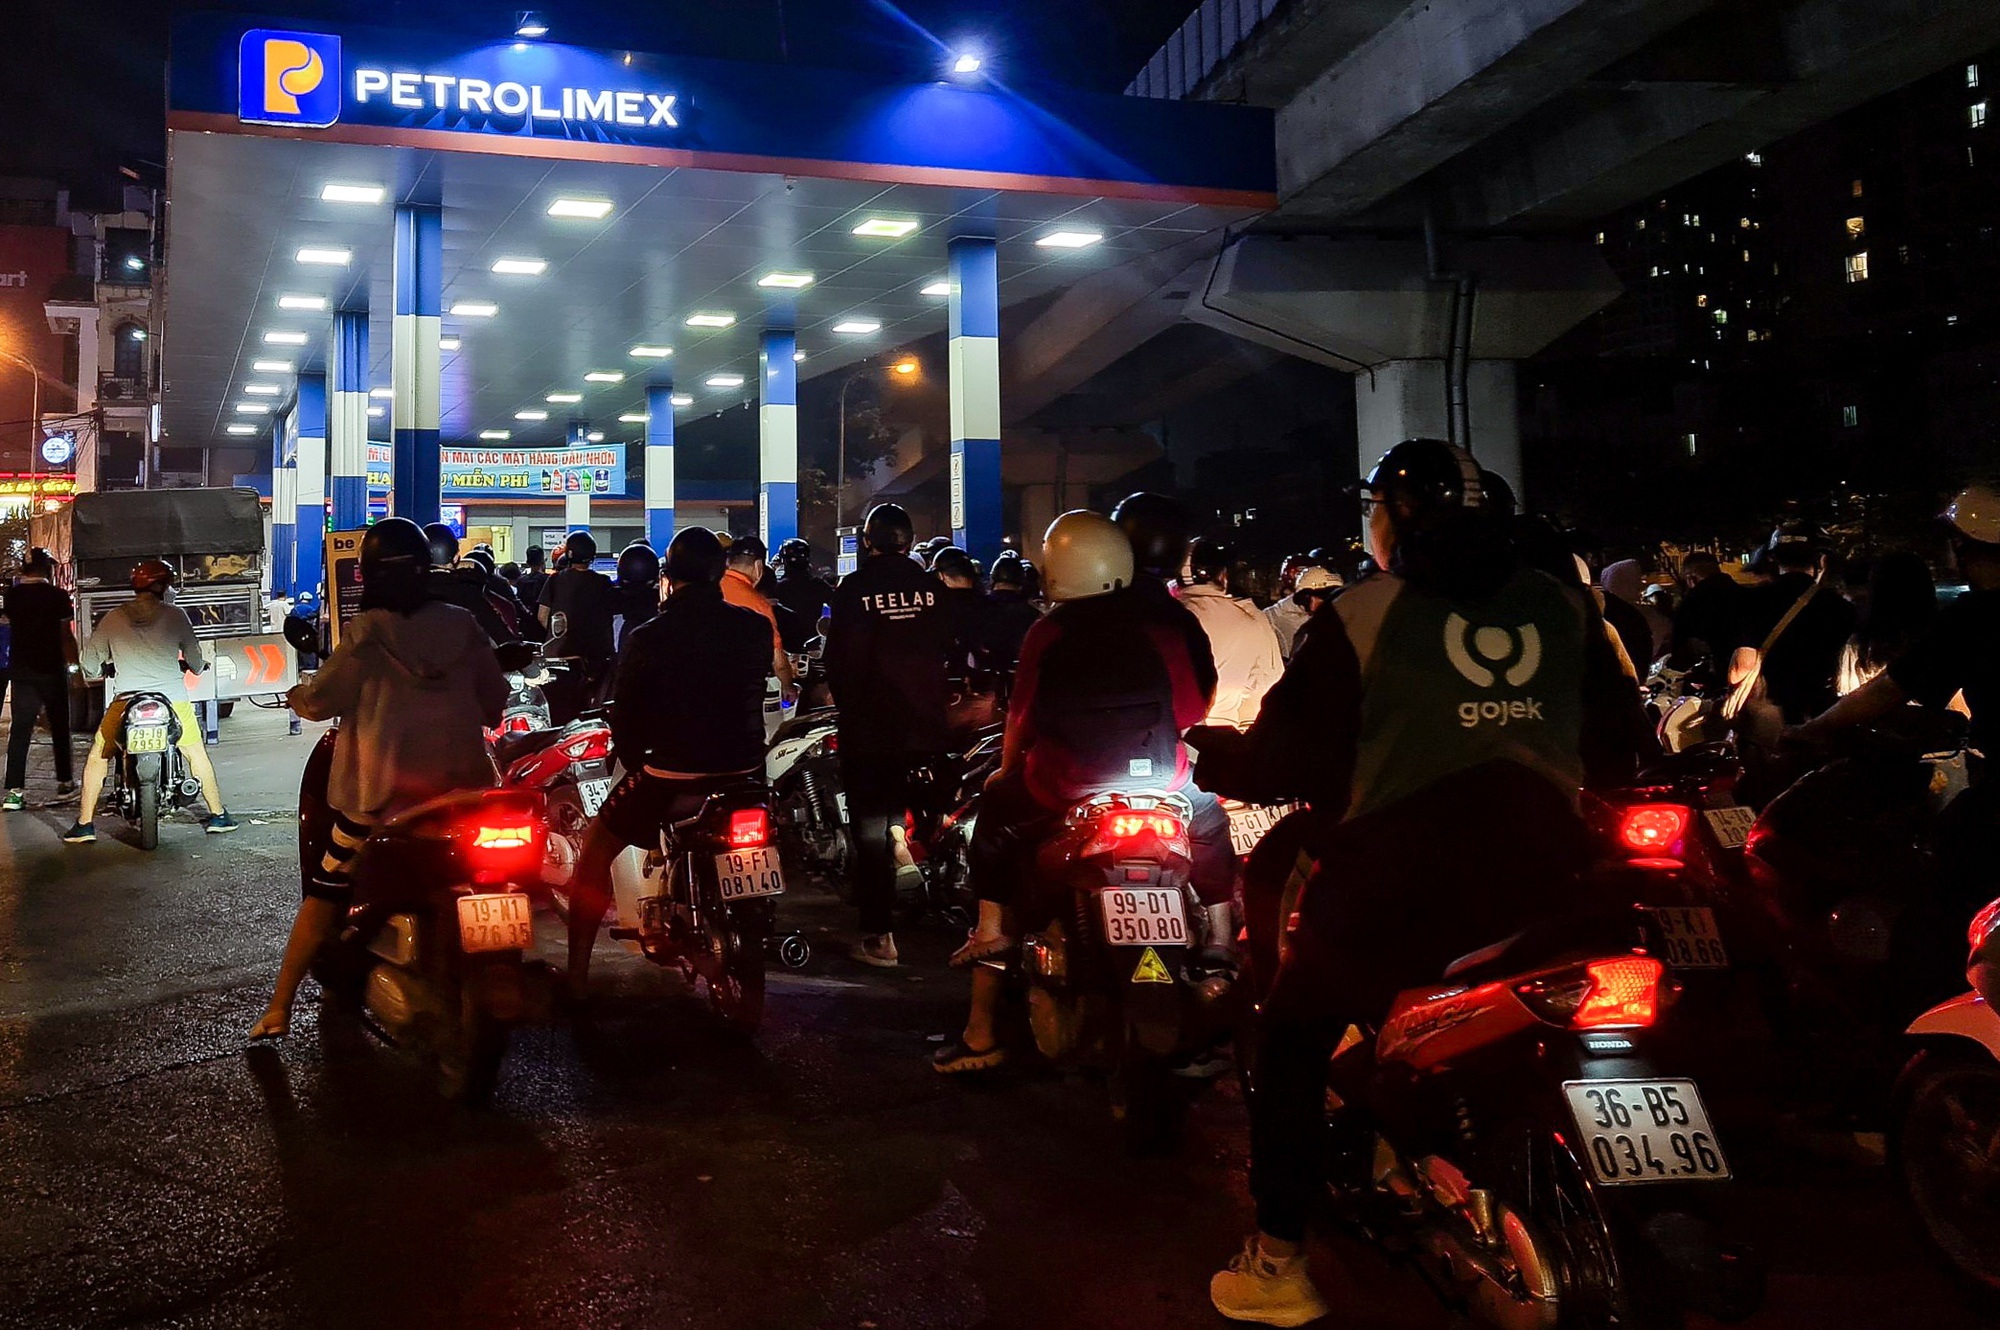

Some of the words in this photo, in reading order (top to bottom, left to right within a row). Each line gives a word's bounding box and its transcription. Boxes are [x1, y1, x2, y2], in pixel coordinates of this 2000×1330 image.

[355, 69, 679, 127] PETROLIMEX
[477, 449, 499, 464] CÁC
[452, 467, 496, 488] MIỄN
[500, 471, 530, 488] PHÍ
[333, 538, 355, 550] be
[861, 591, 936, 612] TEELAB
[1458, 697, 1544, 728] gojek
[585, 780, 610, 798] 34-N
[1230, 813, 1263, 832] 8-G1
[725, 850, 770, 874] 19-F1
[721, 870, 781, 897] 081.40
[471, 898, 520, 922] 19-N1
[1113, 891, 1172, 914] 99-D1
[1109, 917, 1184, 941] 350.80
[1658, 908, 1708, 934] 9-K1
[1588, 1039, 1633, 1050] HONDA
[1585, 1085, 1690, 1129] 36-B5
[1591, 1131, 1720, 1178] 034.96
